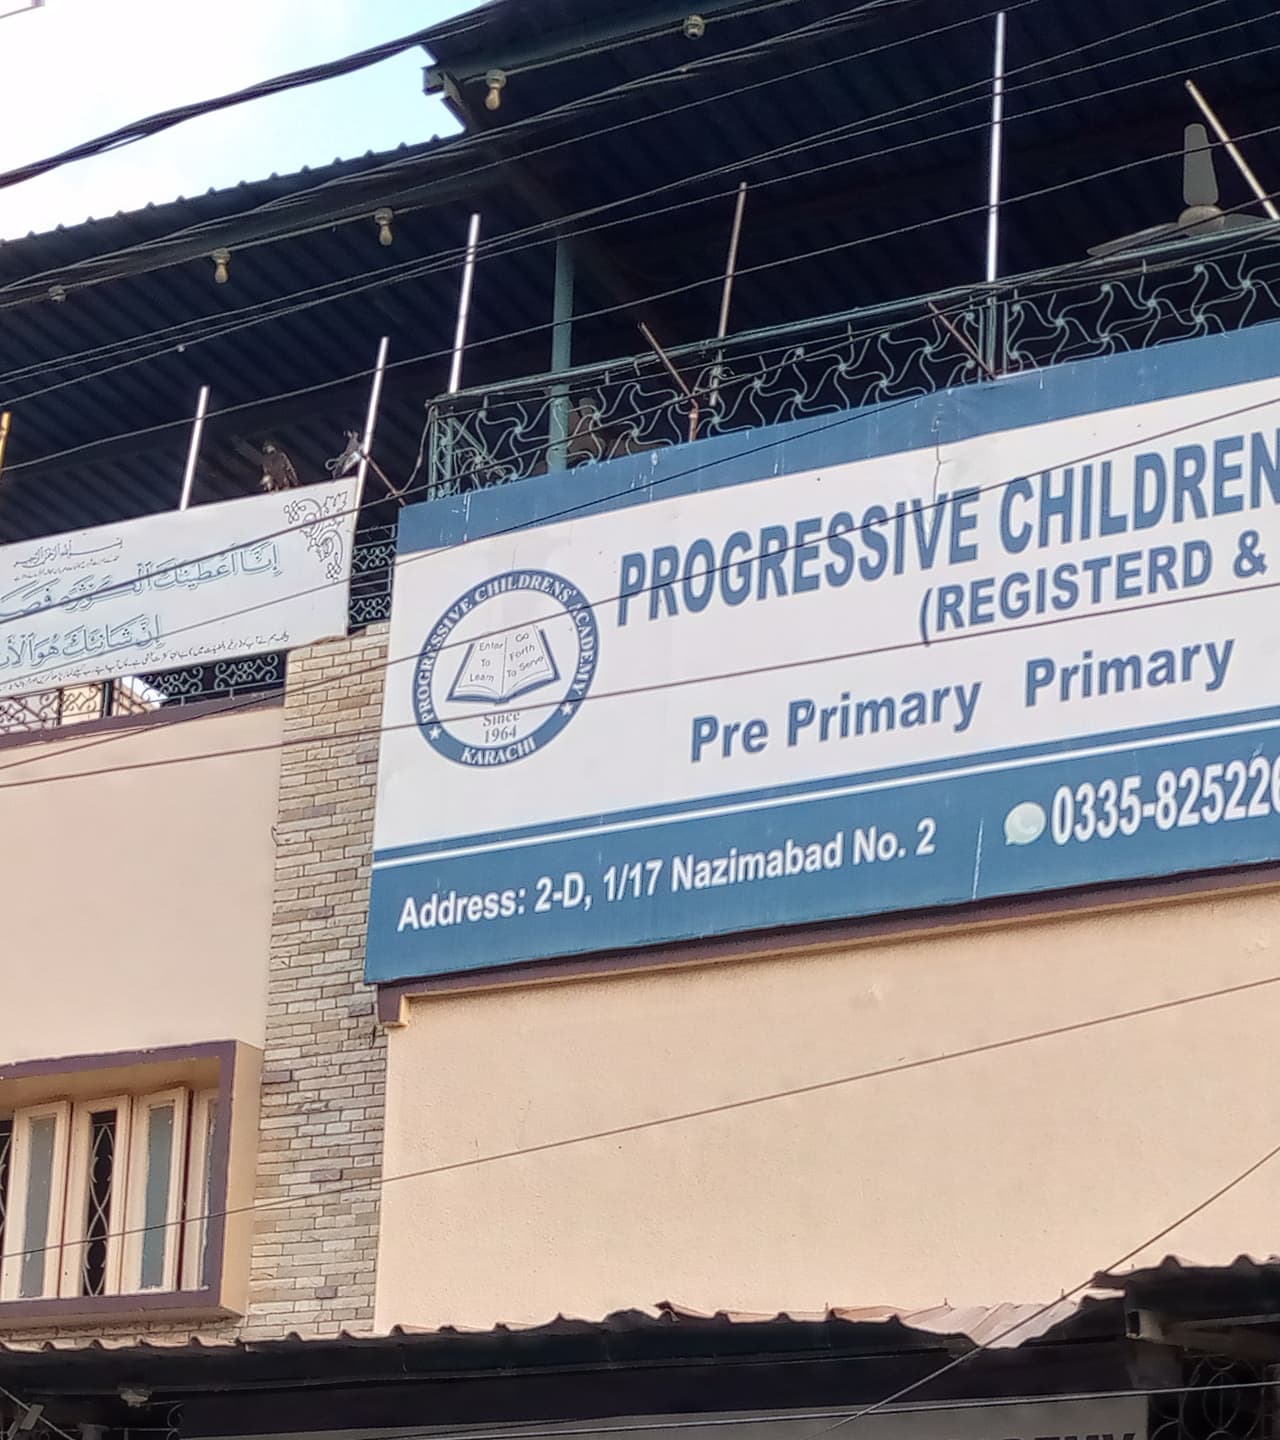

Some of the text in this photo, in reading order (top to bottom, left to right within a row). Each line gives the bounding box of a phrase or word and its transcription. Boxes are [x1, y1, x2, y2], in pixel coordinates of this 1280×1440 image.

[617, 485, 981, 625] PROGRESSIVE
[920, 540, 1212, 644] (REGISTERD
[1233, 529, 1268, 579] &
[417, 598, 472, 722] PROGRESSIVE
[691, 715, 769, 763] Pre
[786, 681, 982, 748] Primary
[1025, 640, 1235, 706] Primary
[461, 737, 537, 765] KARACHI
[483, 713, 520, 727] Since
[484, 726, 518, 744] 1964
[397, 817, 937, 931] Address: 2-D, 1/17 Nazimabad No. 2
